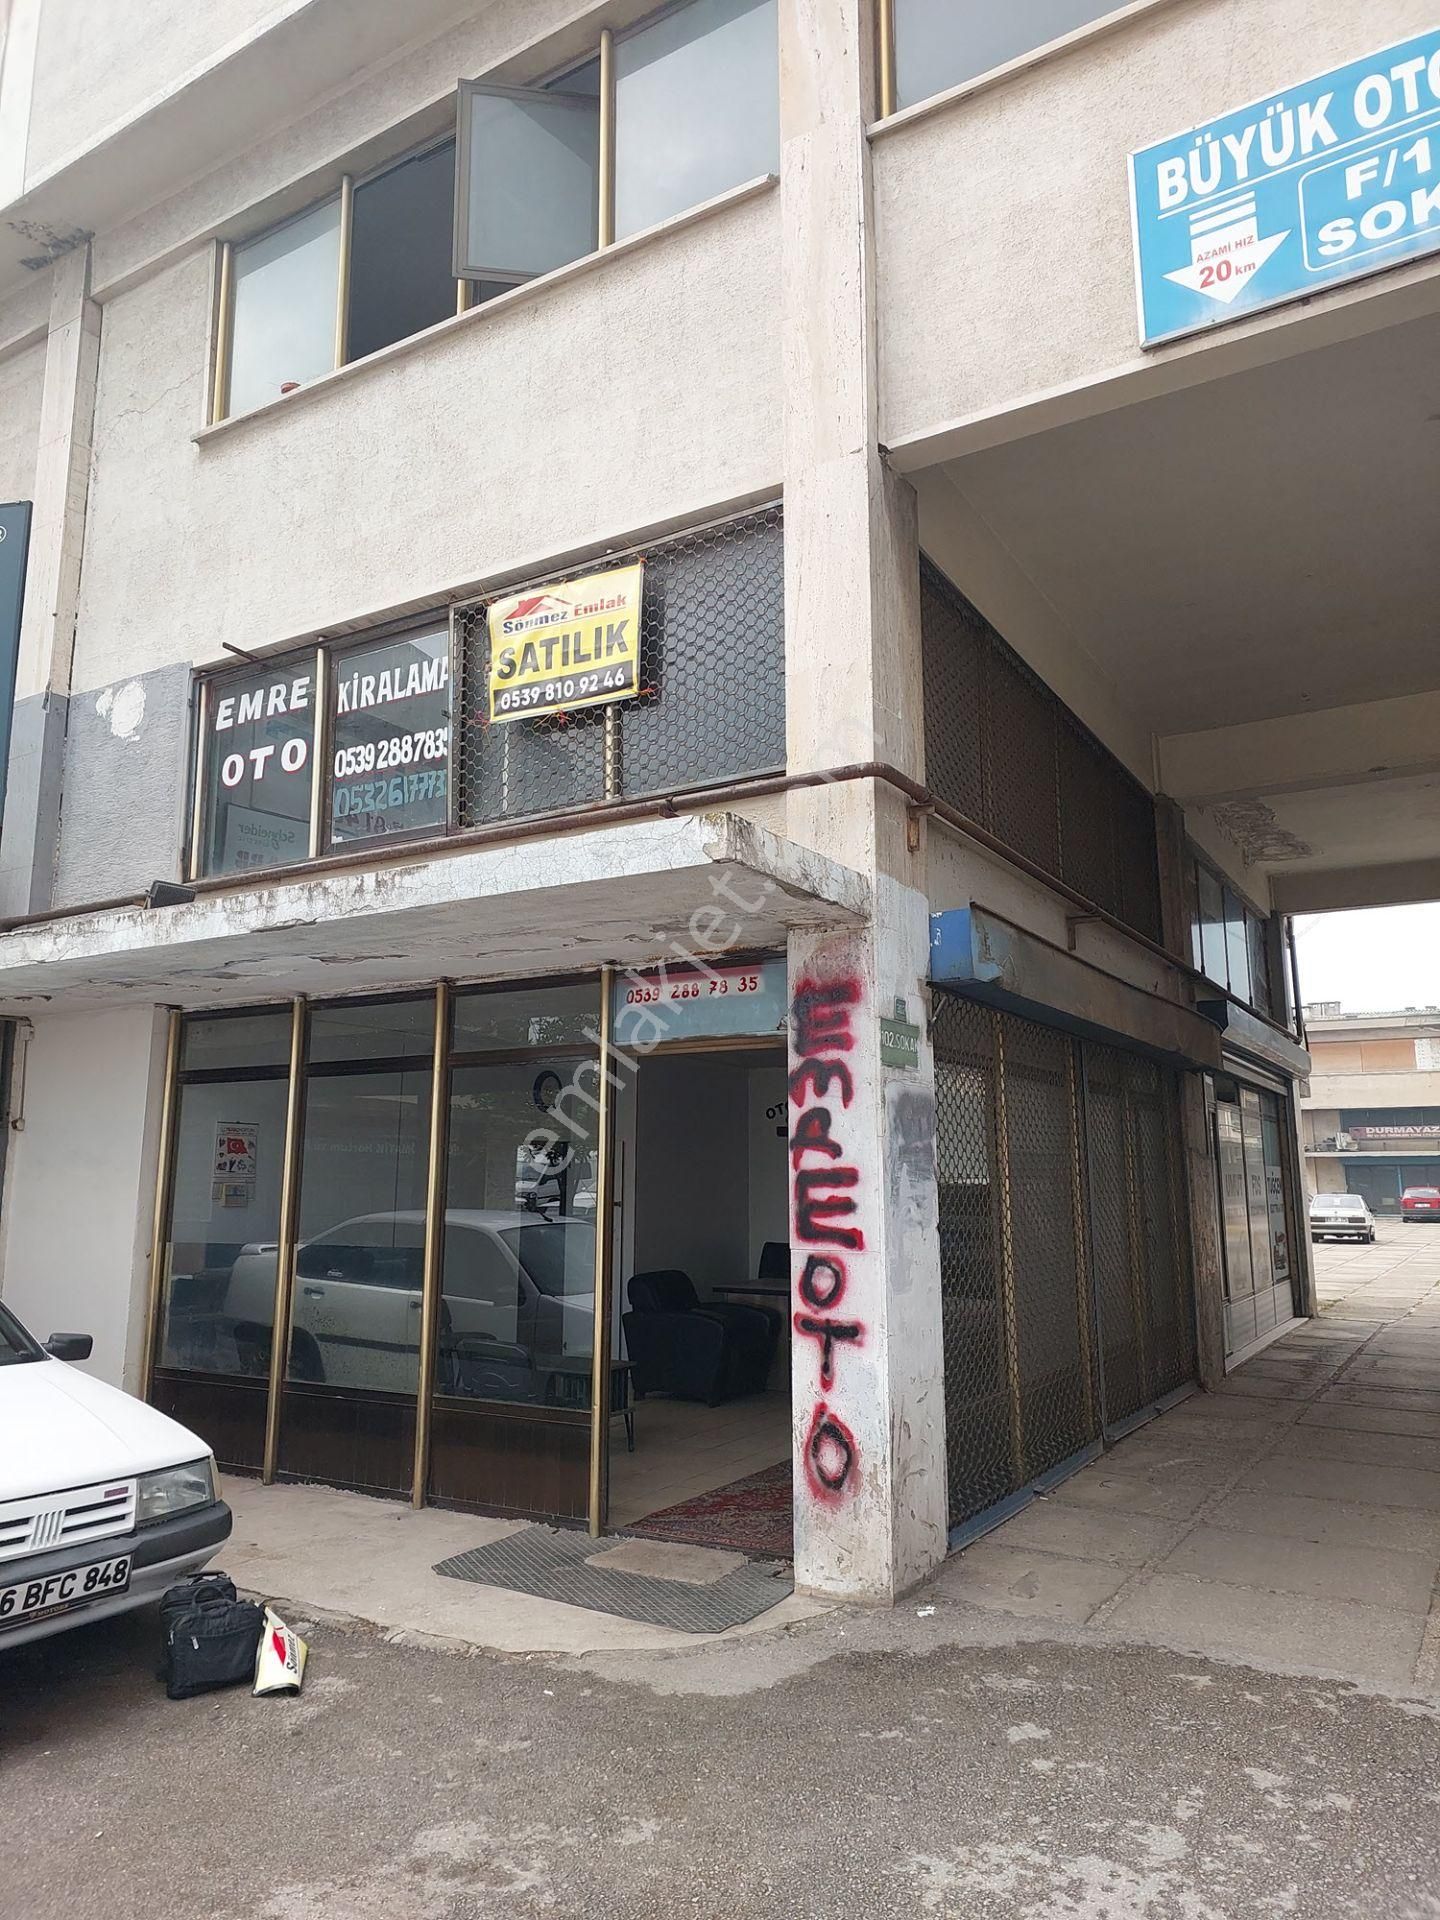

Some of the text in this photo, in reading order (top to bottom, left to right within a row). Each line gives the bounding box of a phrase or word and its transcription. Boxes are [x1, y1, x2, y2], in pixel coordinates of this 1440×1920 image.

[1156, 91, 1339, 211] BÜYÜK
[1344, 136, 1432, 201] F/1
[1196, 233, 1255, 263] AZAMİ HIZ
[1198, 258, 1257, 290] 20 km
[502, 593, 627, 635] Sönmez Emlak
[496, 618, 630, 681] SATILIK
[215, 675, 311, 732] EMRE
[337, 655, 449, 715] KİRALAMA
[500, 667, 626, 710] 0539 810 92 46
[221, 737, 308, 788] OTO
[626, 974, 760, 1005] 0539 288 78 35
[765, 1100, 789, 1120] OT
[22, 1572, 77, 1611] BFC
[83, 1558, 129, 1592] 848
